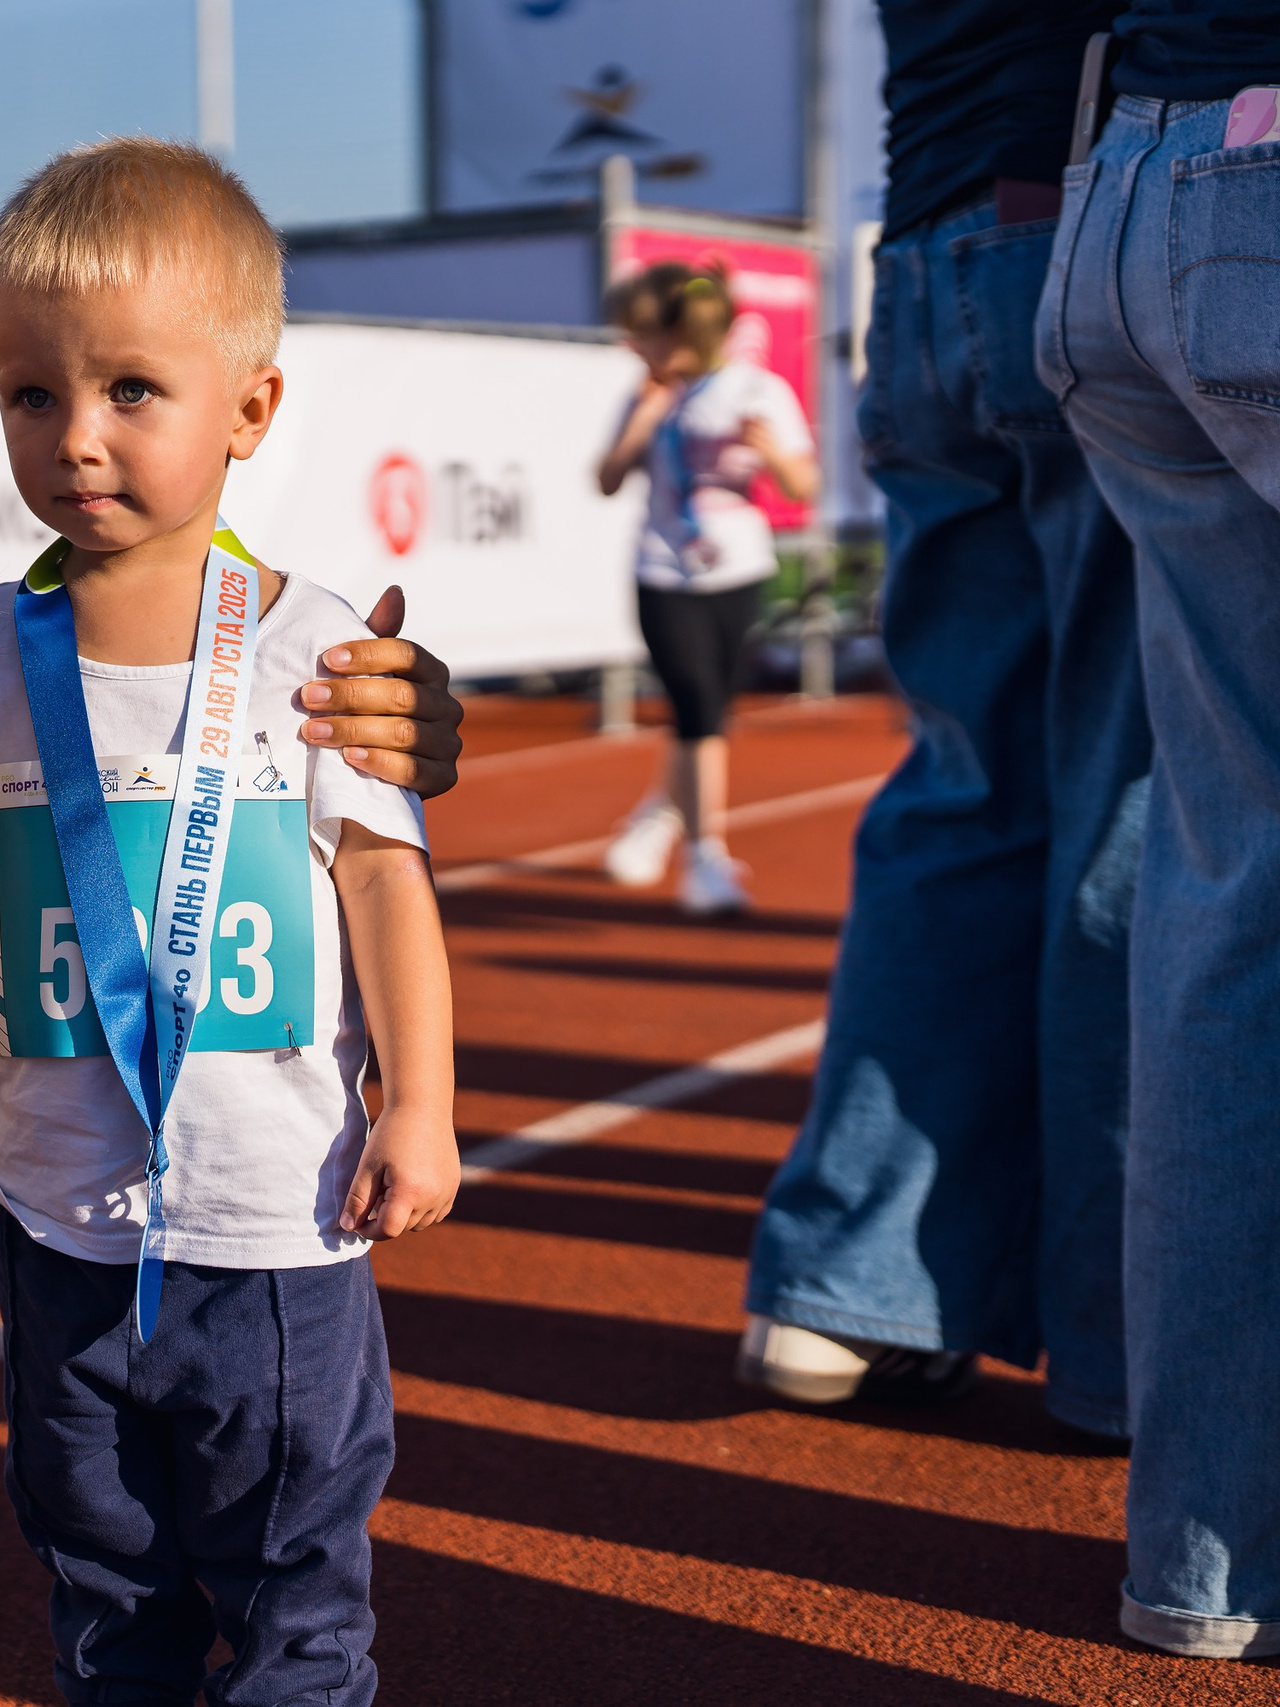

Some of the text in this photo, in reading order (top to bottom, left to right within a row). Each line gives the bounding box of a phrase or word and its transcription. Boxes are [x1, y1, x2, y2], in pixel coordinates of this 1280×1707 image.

[2, 780, 39, 793] СПОРТ
[168, 568, 247, 957] СТАНЬ ПЕРВЫМ 29 АВГУСТА 2025
[39, 900, 274, 1021] 53
[170, 968, 192, 1081] СПОРТ 40
